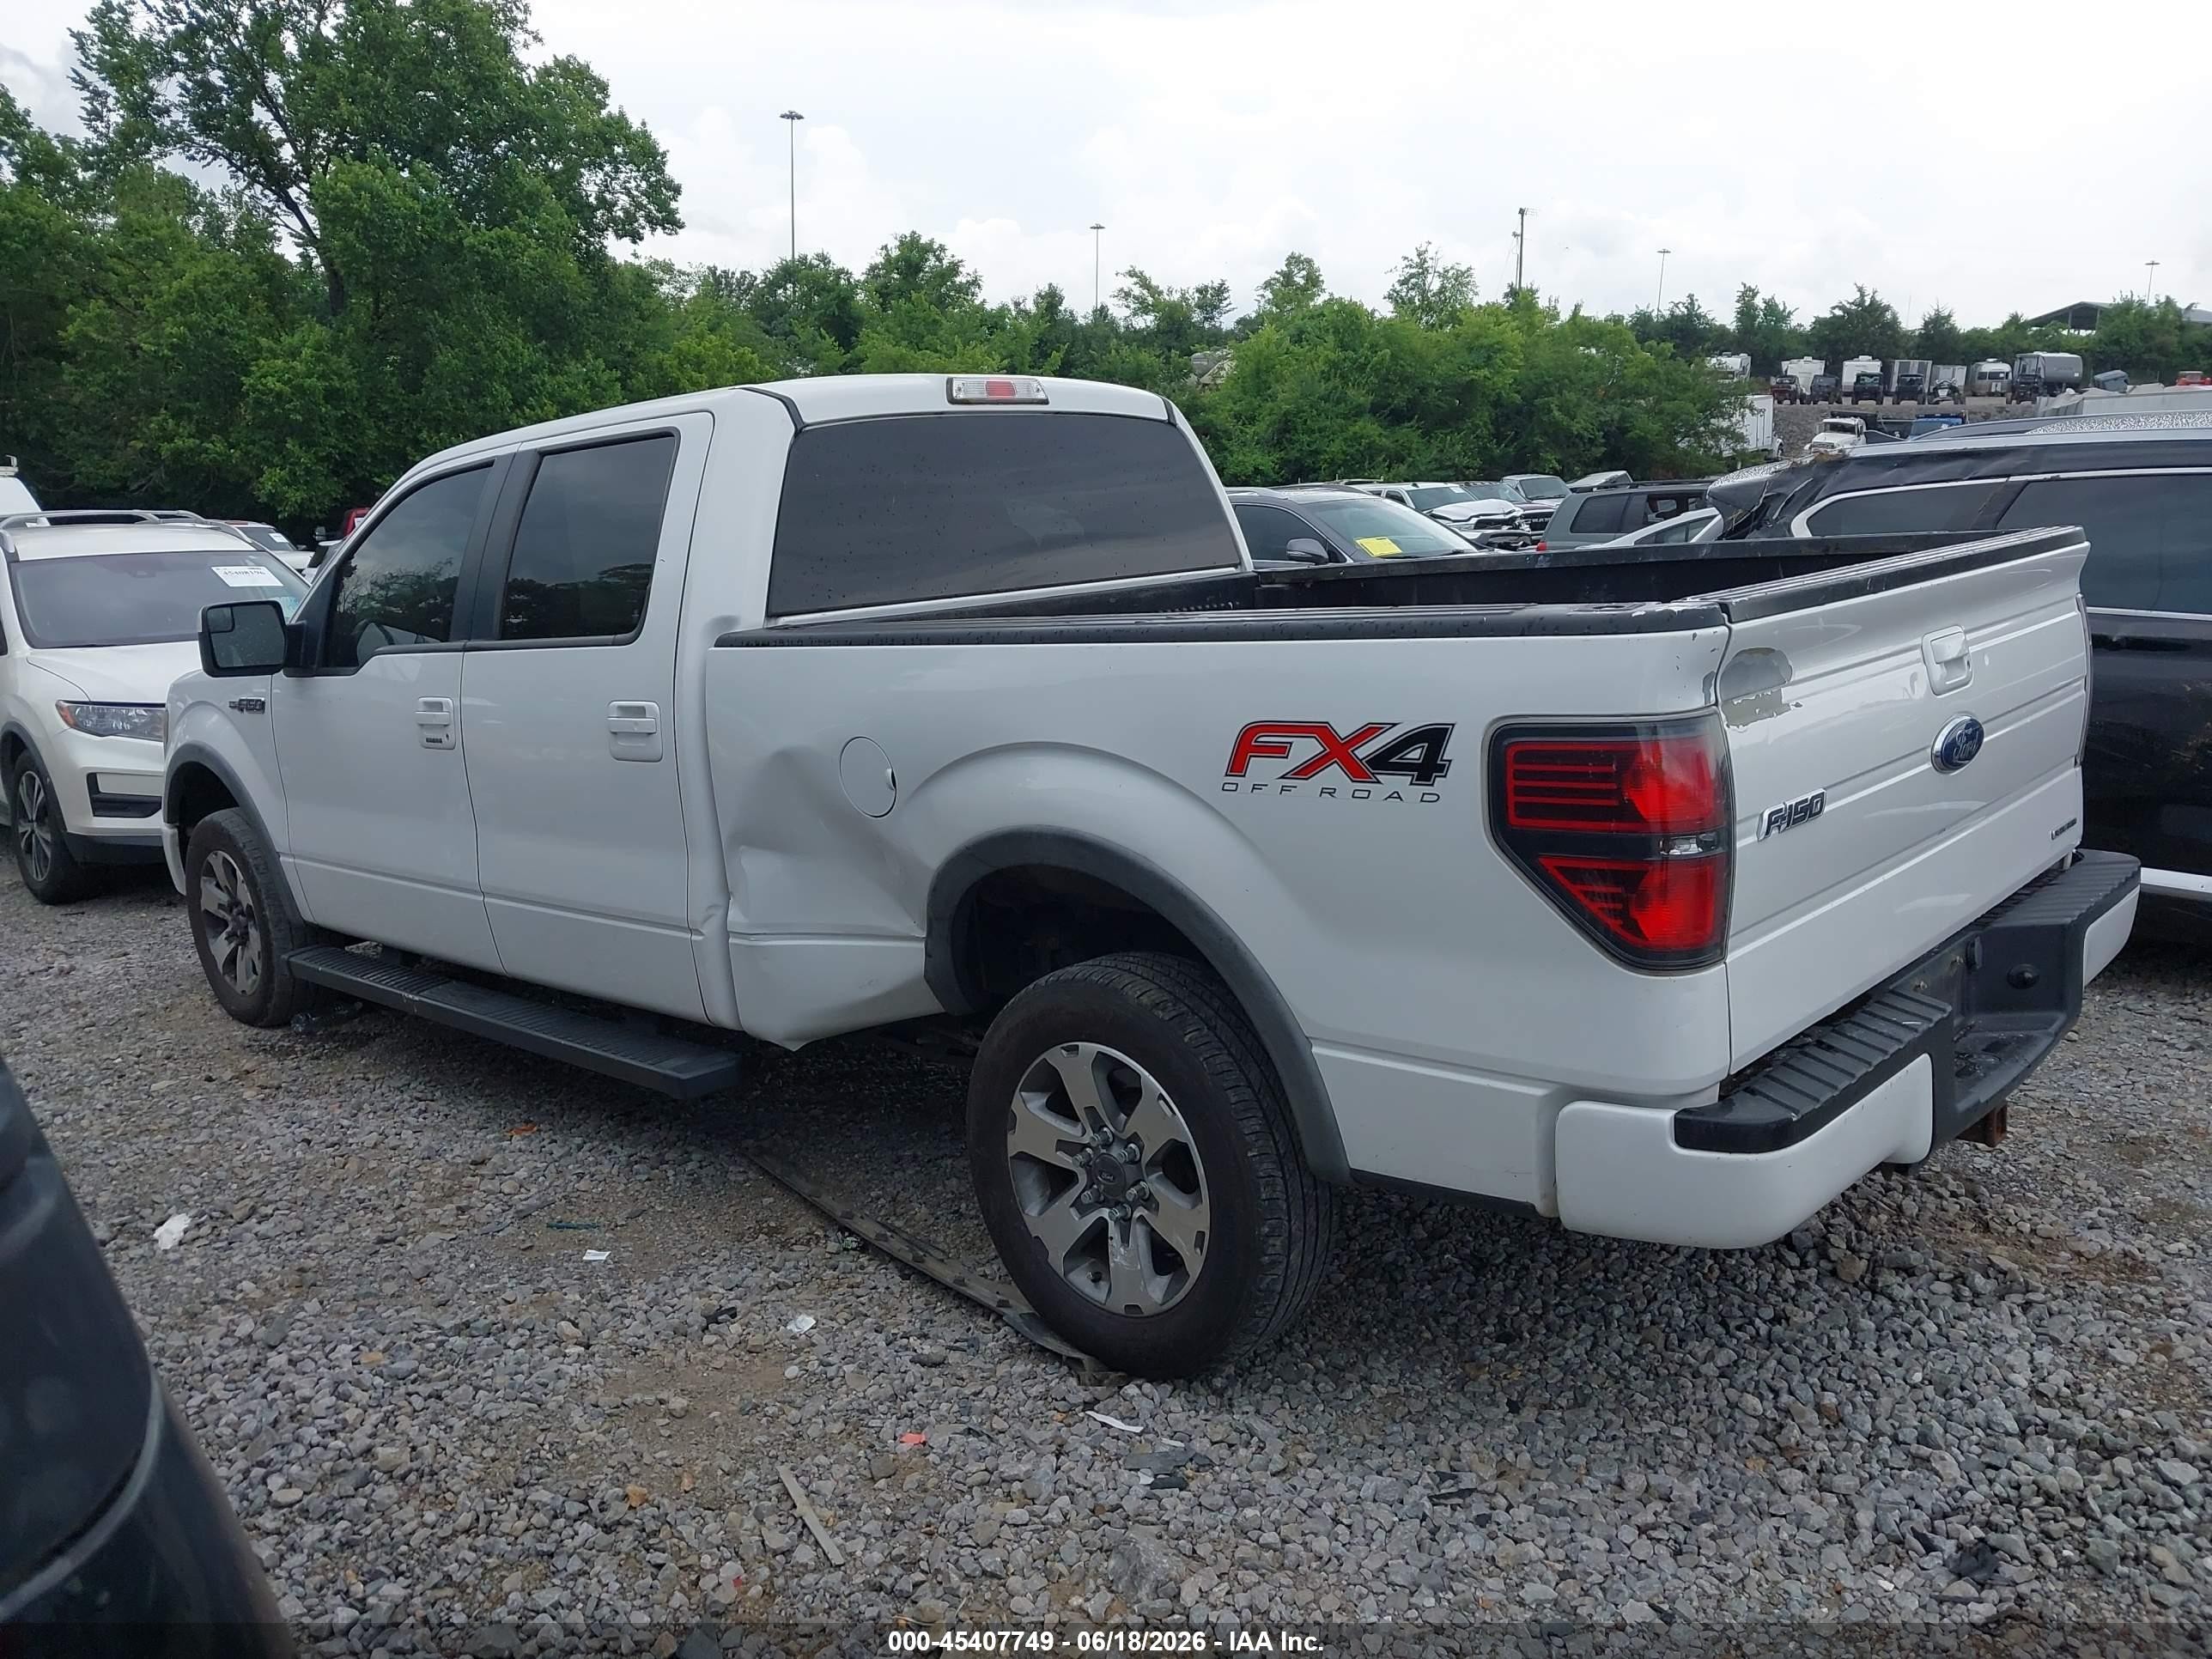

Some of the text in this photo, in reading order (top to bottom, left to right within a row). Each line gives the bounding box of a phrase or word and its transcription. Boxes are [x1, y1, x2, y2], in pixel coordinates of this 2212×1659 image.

[1224, 720, 1455, 786] FX4
[1221, 782, 1440, 803] OFF ROAD
[1760, 789, 1827, 840] F-150
